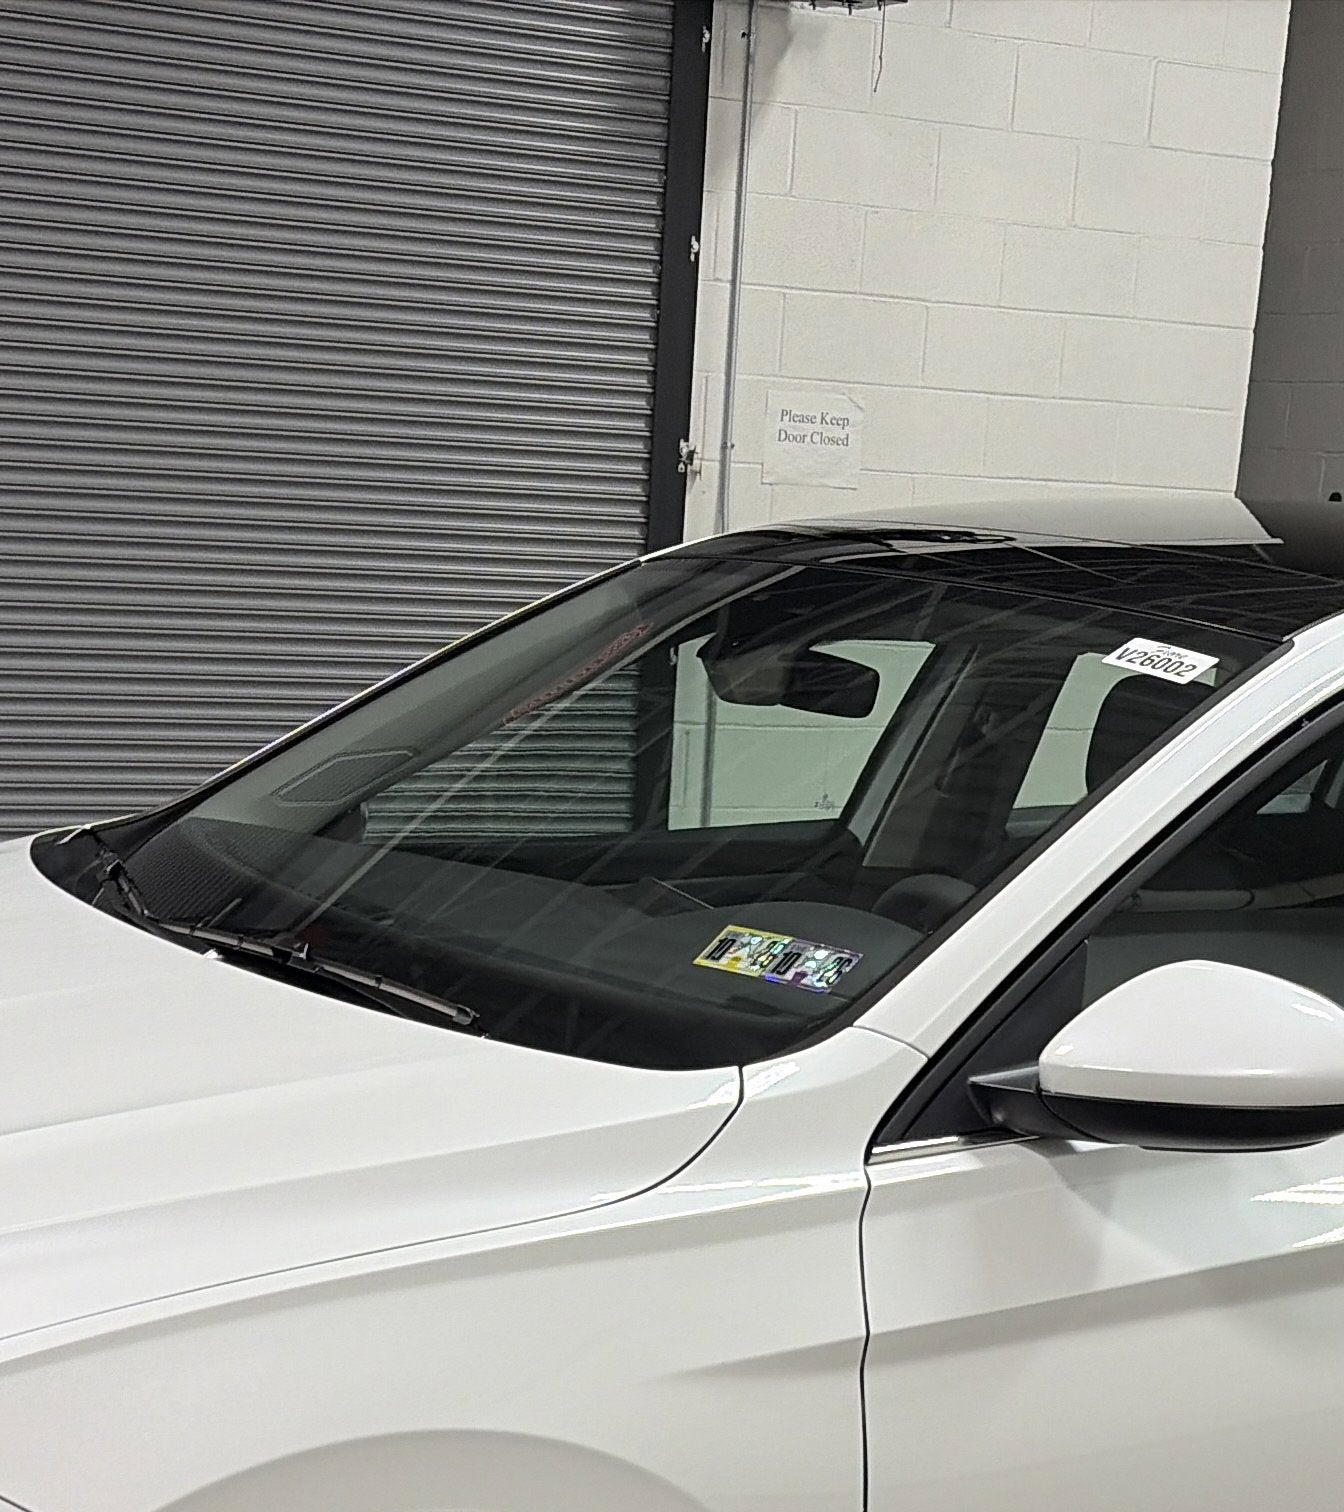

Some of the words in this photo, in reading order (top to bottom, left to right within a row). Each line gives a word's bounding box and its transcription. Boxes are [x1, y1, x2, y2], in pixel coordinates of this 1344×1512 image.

[780, 408, 817, 424] Please
[820, 411, 850, 430] Keep
[777, 428, 808, 444] Door
[810, 431, 850, 447] Closed
[1115, 647, 1198, 677] V26002
[705, 937, 737, 961] 10
[770, 951, 803, 975] 10
